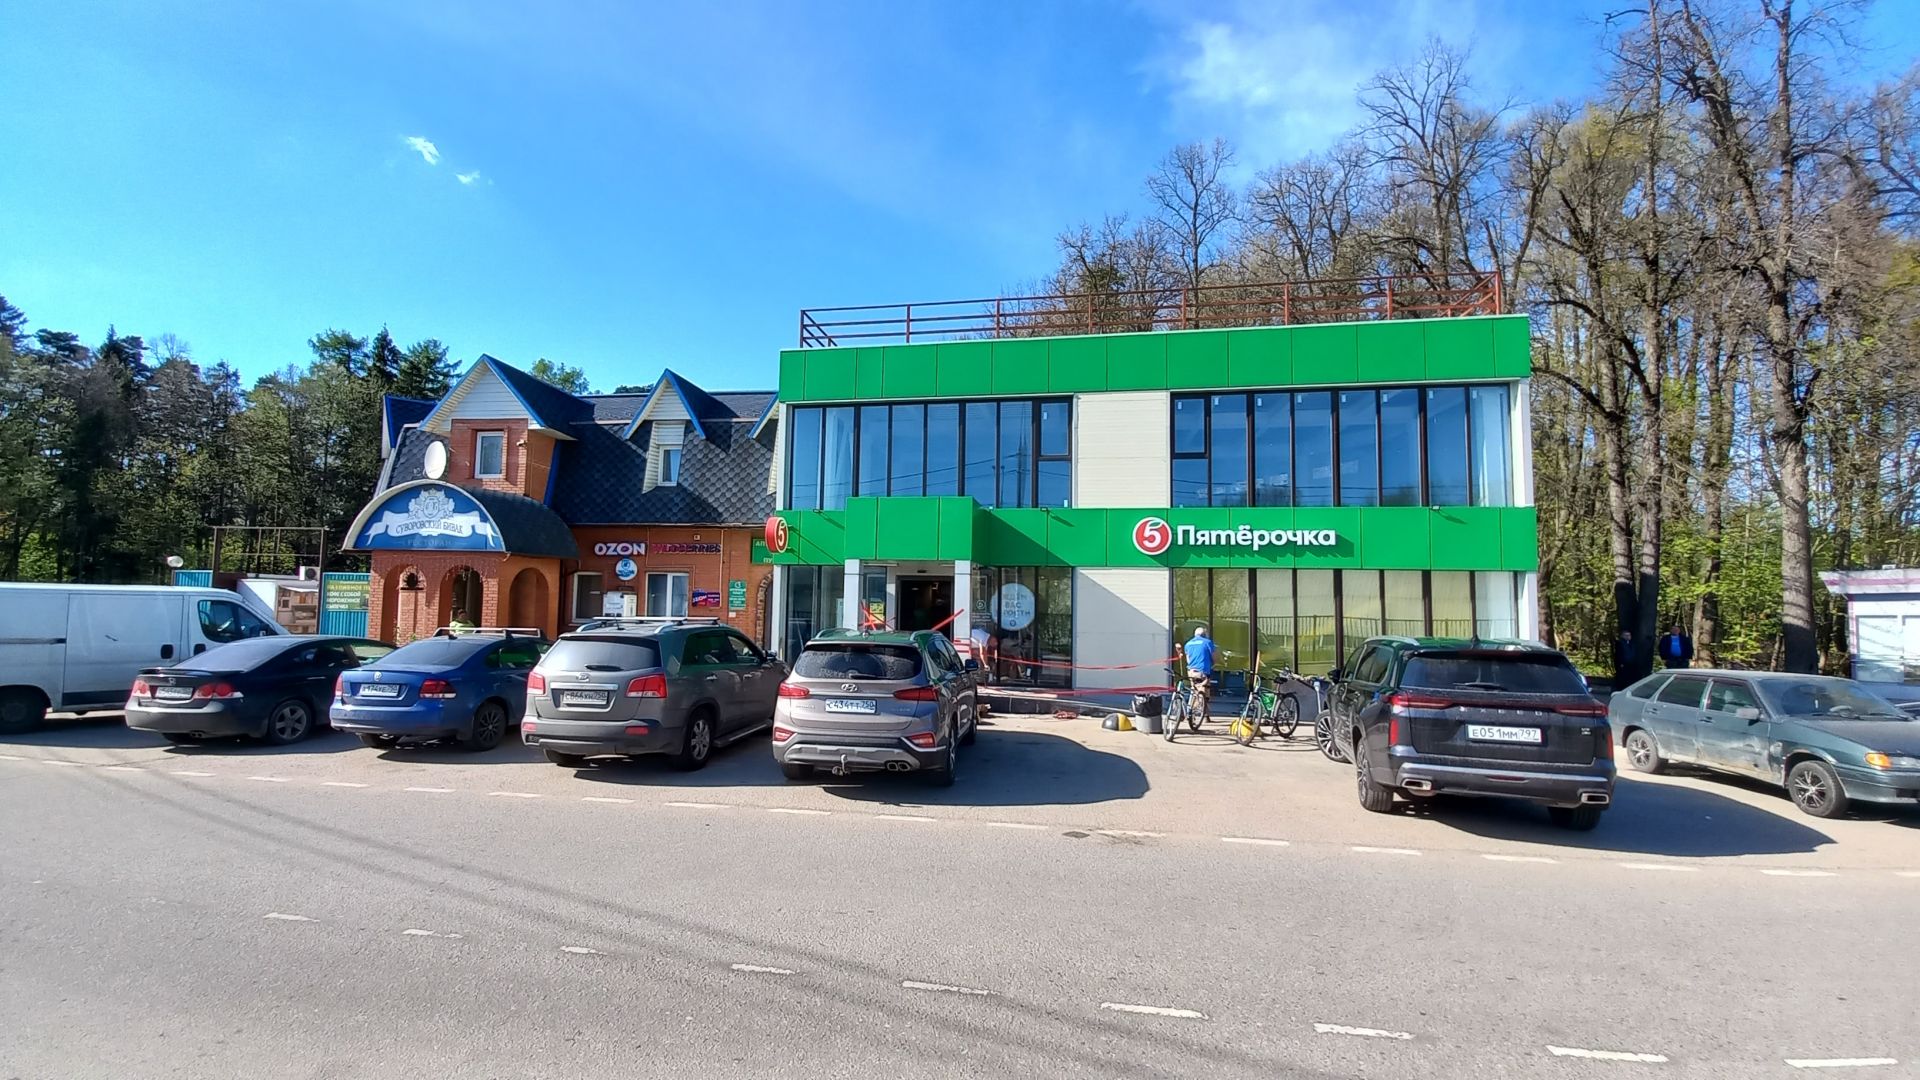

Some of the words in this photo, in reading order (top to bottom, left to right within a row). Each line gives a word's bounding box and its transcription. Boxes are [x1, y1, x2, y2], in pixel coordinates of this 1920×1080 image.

[395, 520, 441, 534] СУВОРОВСКИЙ
[443, 521, 464, 535] БИВАК
[1143, 519, 1163, 547] 5
[1177, 524, 1336, 551] Пятёрочка
[594, 543, 646, 556] OZON
